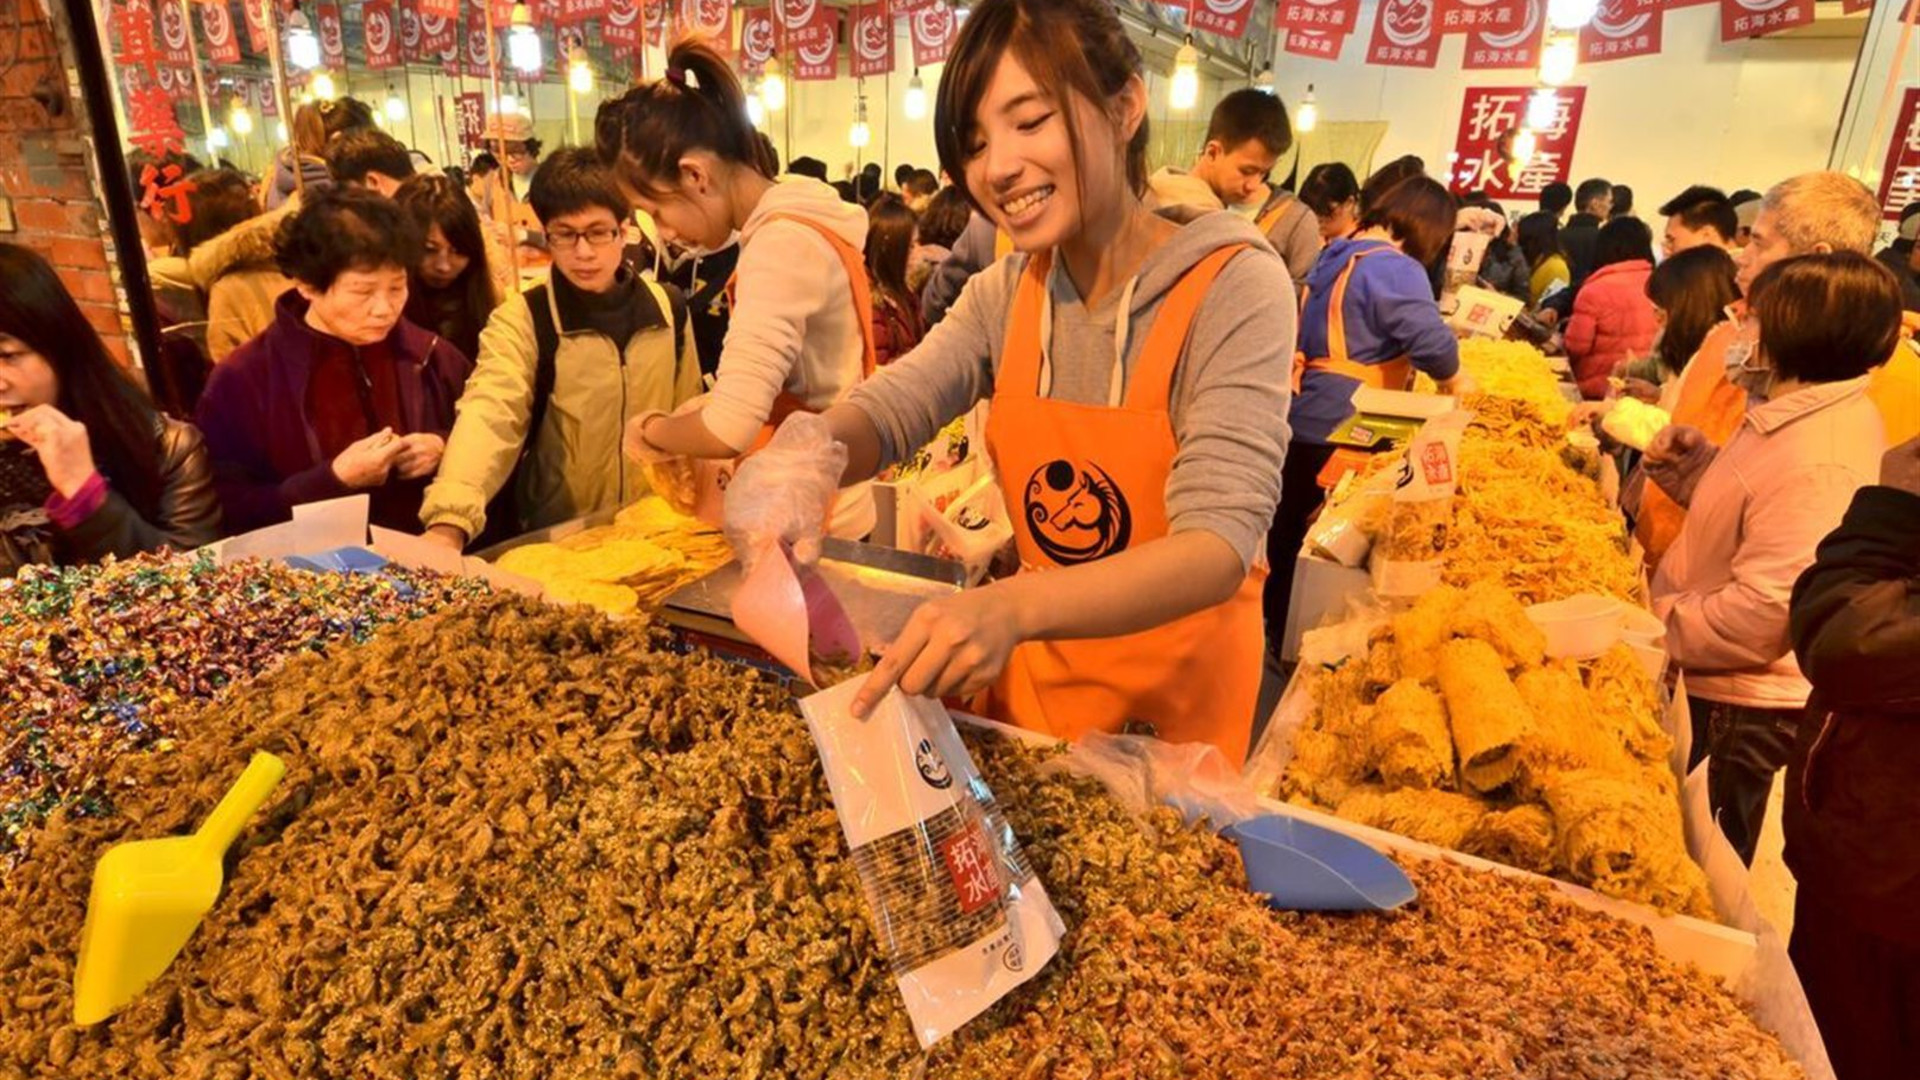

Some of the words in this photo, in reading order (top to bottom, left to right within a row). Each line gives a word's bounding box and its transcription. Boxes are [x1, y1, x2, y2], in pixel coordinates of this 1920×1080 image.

[1194, 11, 1237, 32] 拓海水產
[1286, 6, 1346, 24] 拓海水產
[1443, 7, 1512, 25] 拓海水產
[1734, 6, 1800, 32] 拓海水產
[1376, 46, 1428, 62] 拓海水產
[1589, 36, 1649, 55] 拓海水產
[1472, 49, 1528, 63] 拓海水產
